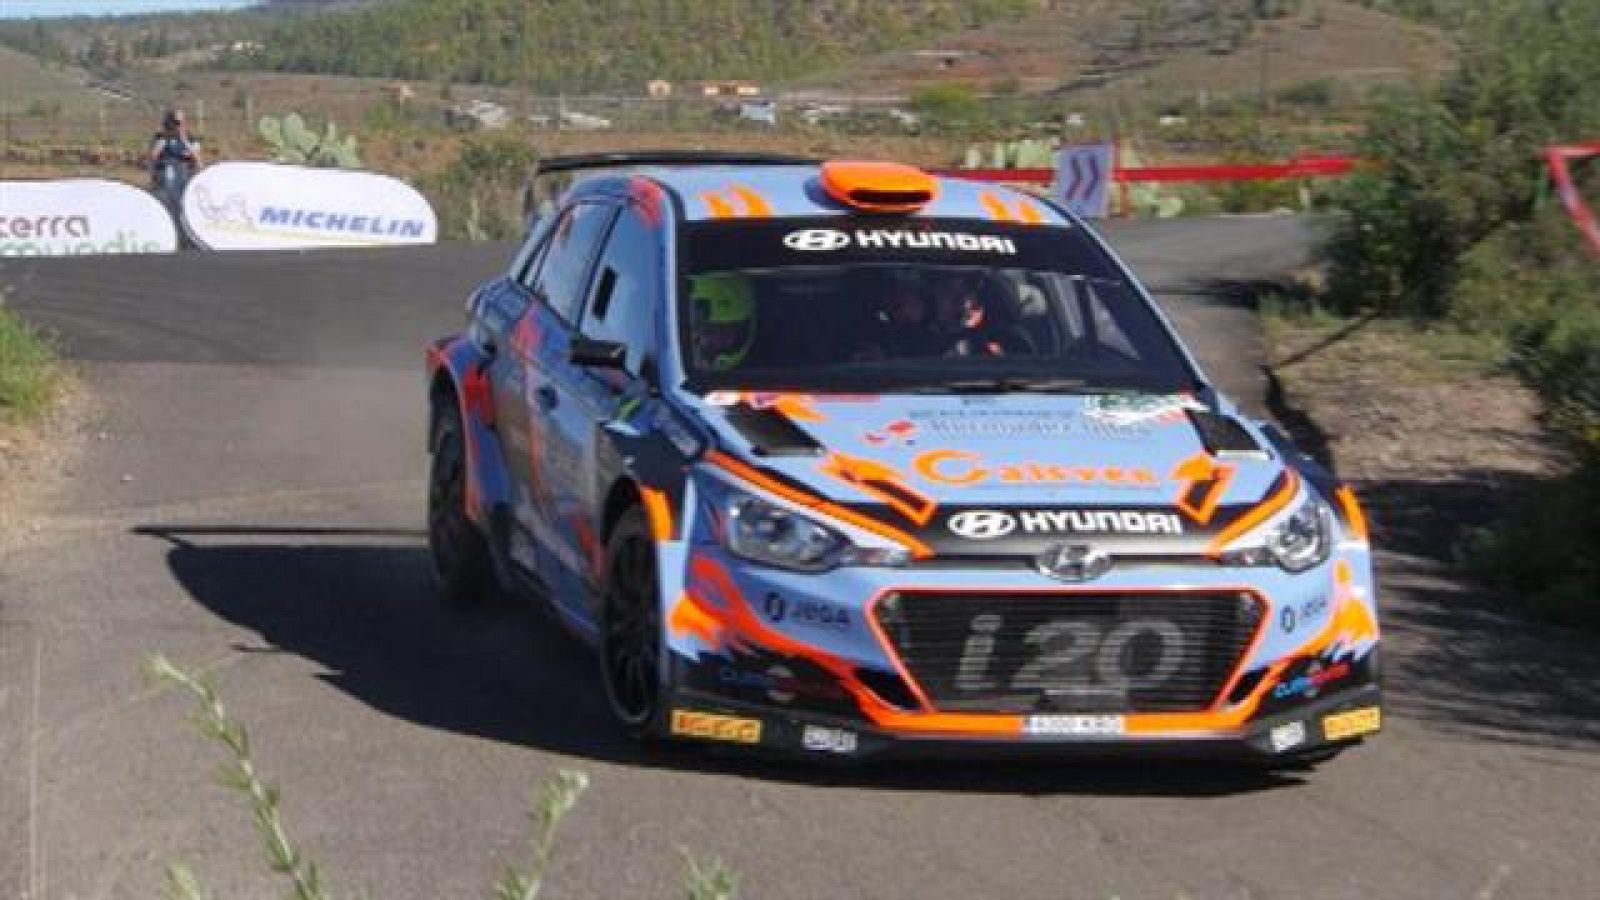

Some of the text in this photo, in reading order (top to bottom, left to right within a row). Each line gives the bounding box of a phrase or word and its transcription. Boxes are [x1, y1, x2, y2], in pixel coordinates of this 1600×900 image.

[259, 206, 424, 238] MICHELIN
[854, 229, 1017, 255] HYUNDAI
[1019, 510, 1183, 535] HYUNDAI
